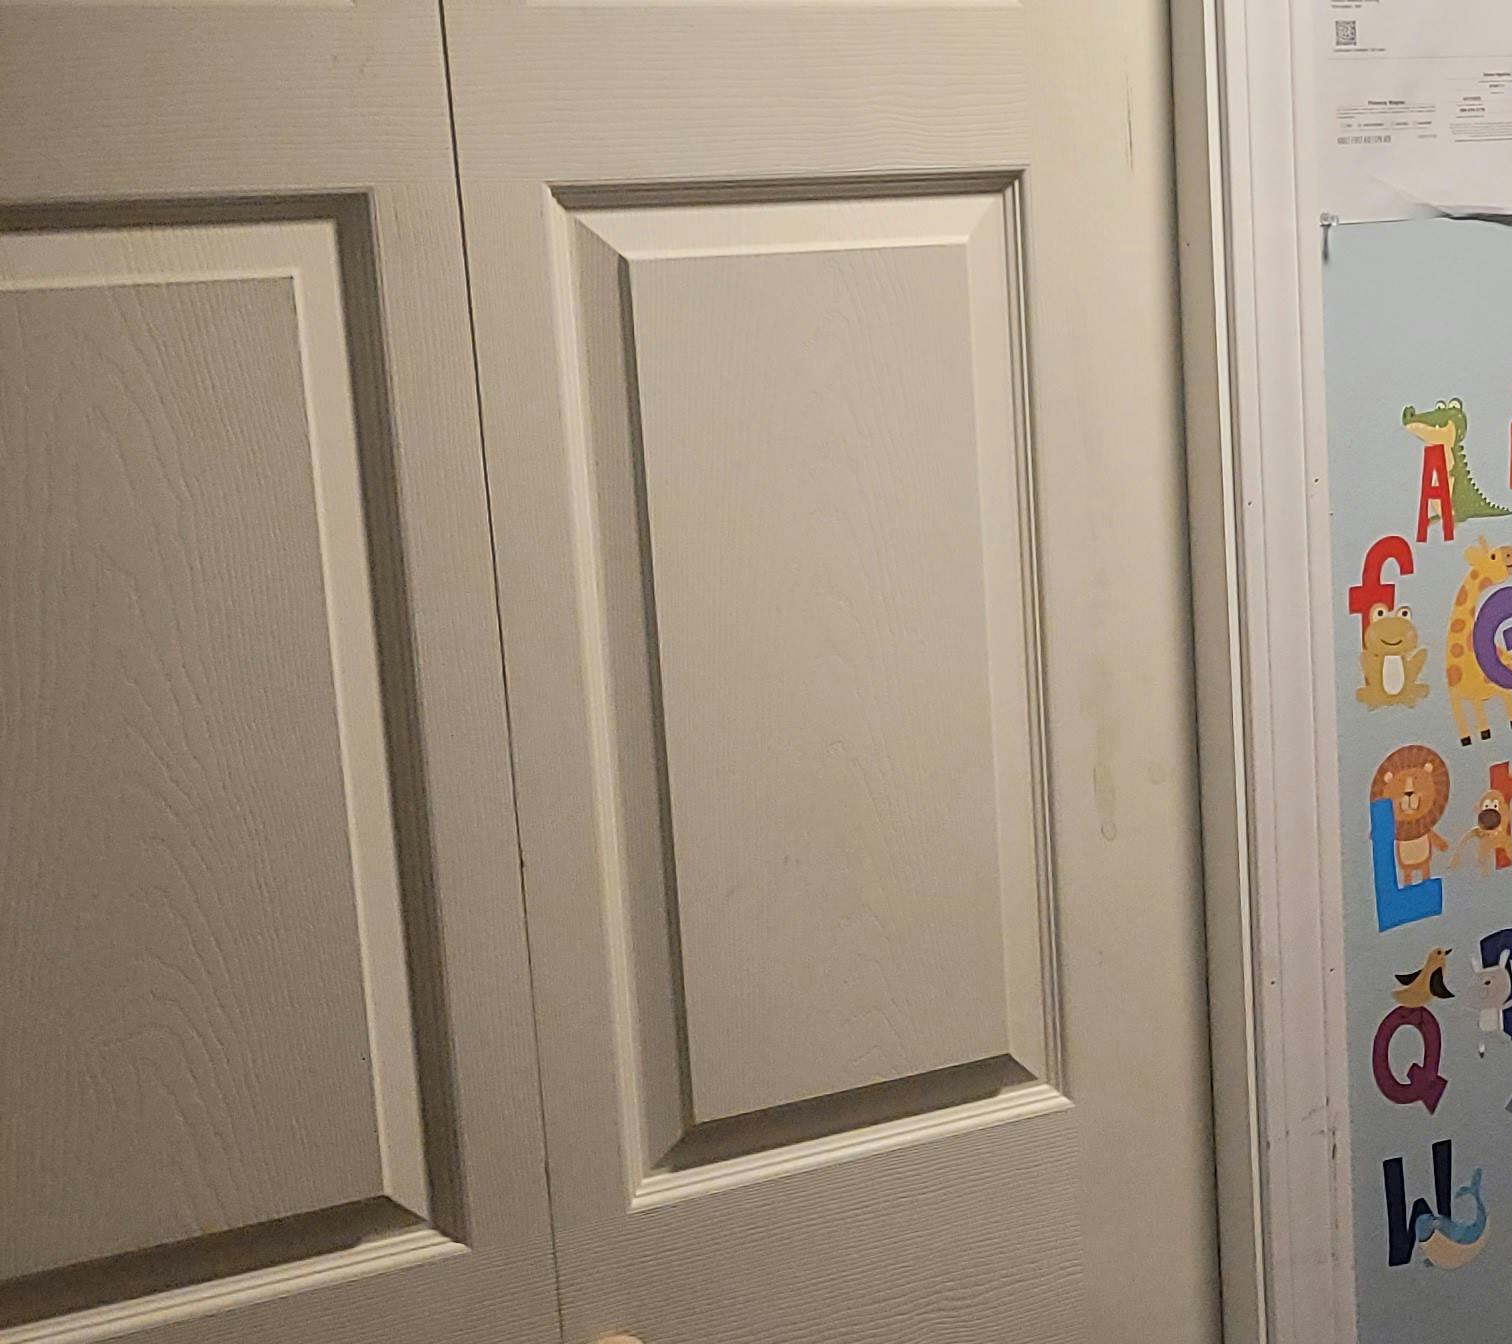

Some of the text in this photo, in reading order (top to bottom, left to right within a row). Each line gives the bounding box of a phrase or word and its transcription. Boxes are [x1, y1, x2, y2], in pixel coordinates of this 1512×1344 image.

[1416, 443, 1455, 543] A
[1369, 798, 1443, 932] L
[1371, 1006, 1448, 1116] Q
[1381, 1139, 1454, 1267] W
